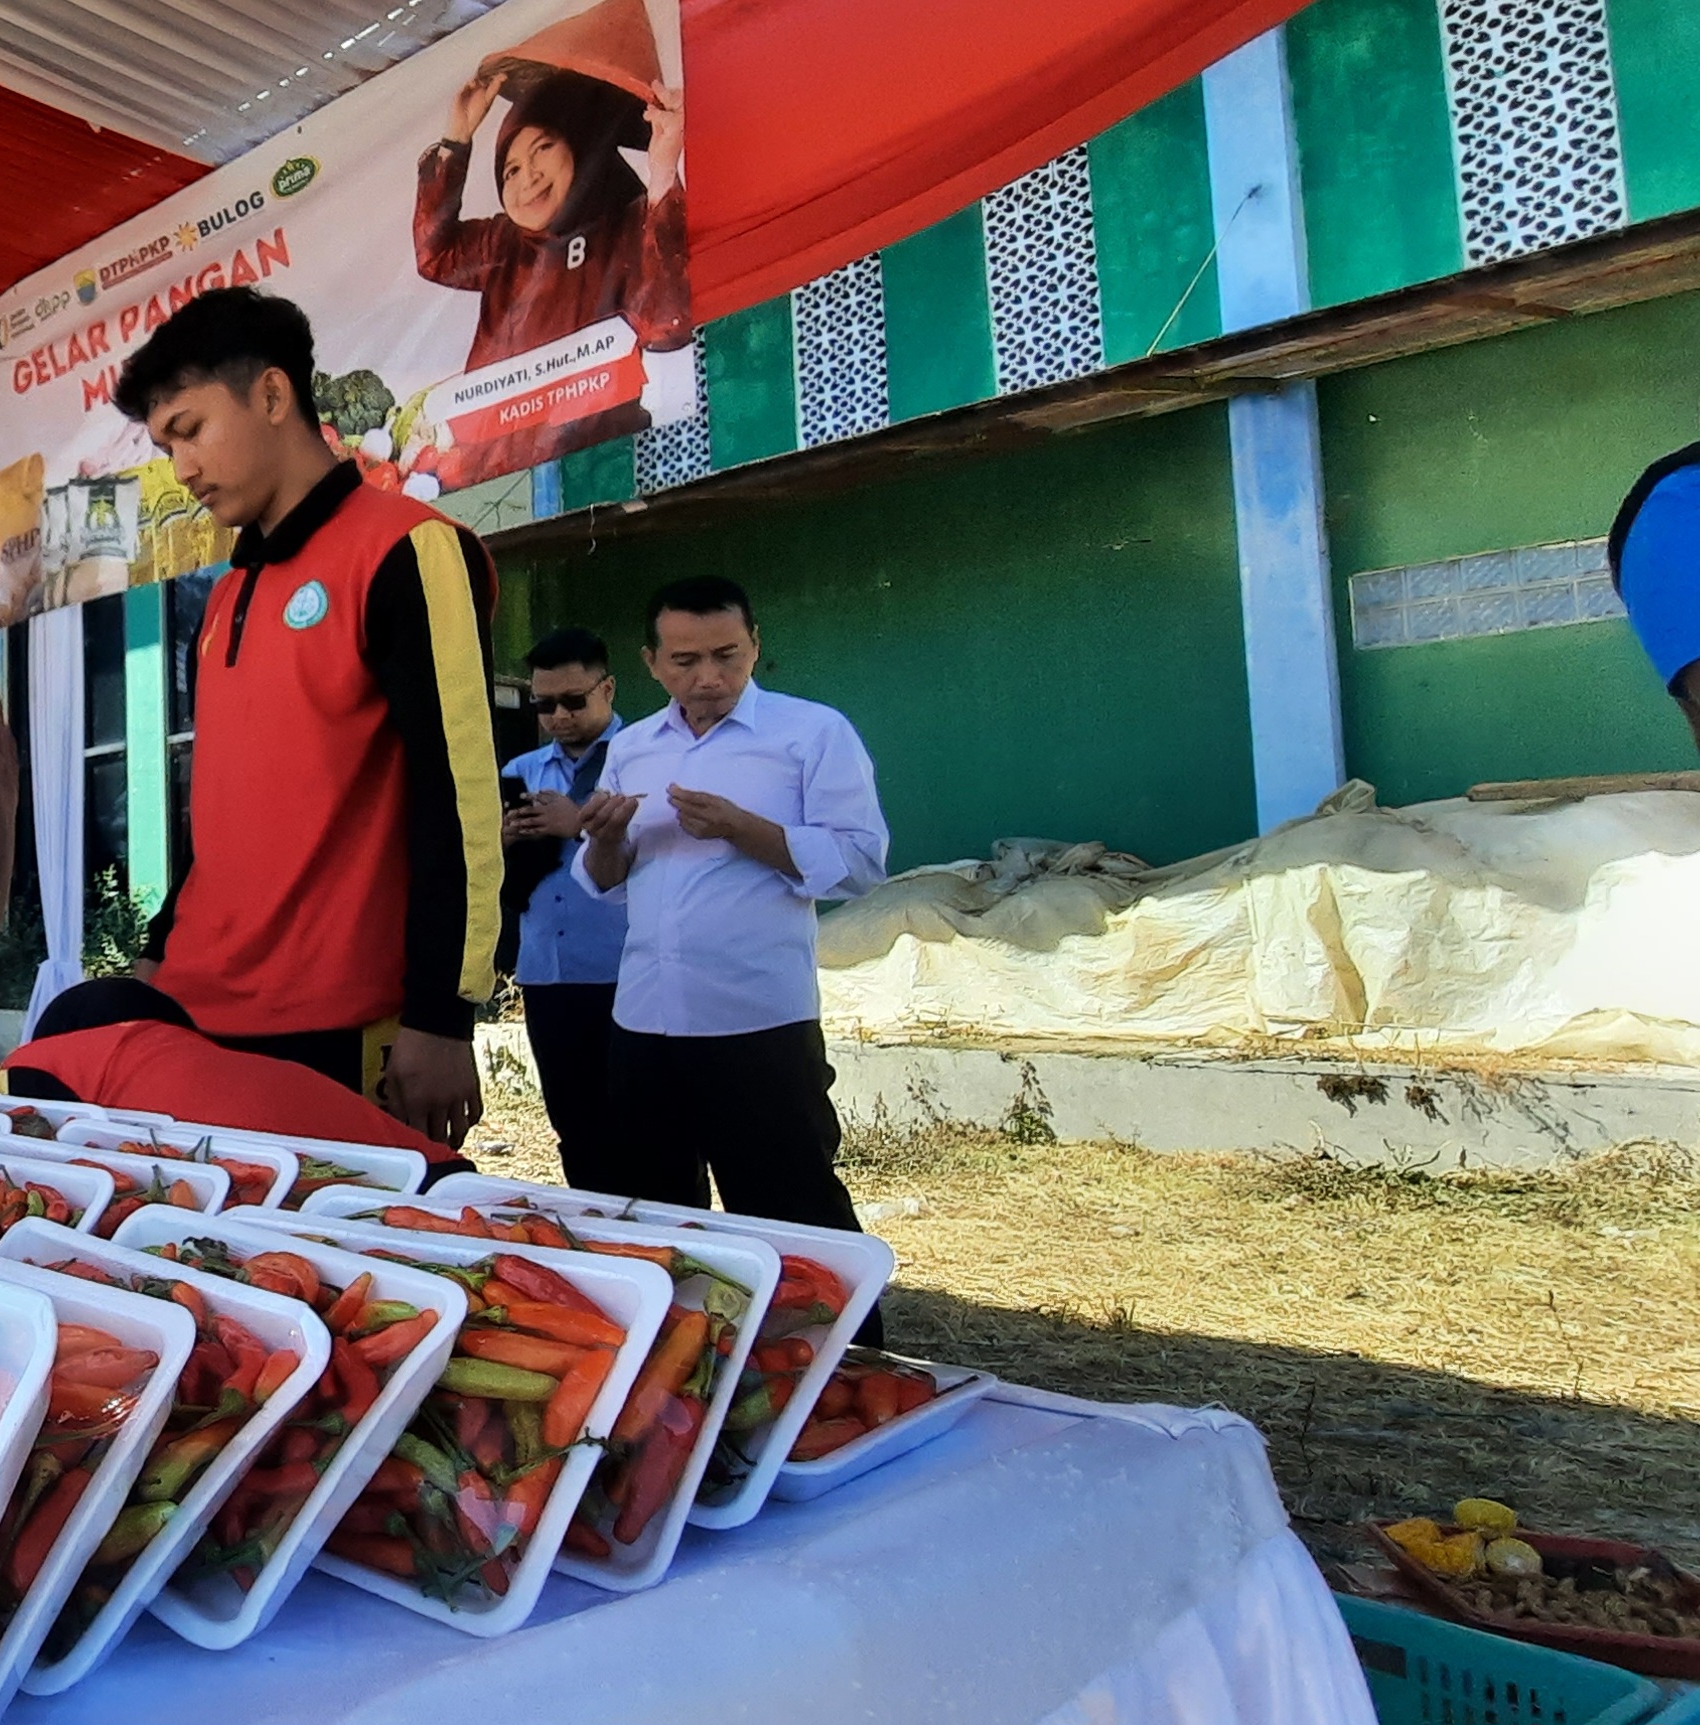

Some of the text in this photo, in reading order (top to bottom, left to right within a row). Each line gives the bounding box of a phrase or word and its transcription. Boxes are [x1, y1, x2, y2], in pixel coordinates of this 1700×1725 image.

[278, 165, 311, 192] prima
[196, 190, 266, 238] BULOG
[566, 236, 587, 271] B
[13, 320, 111, 394] GELAR
[119, 228, 290, 342] PANGAN
[454, 368, 531, 404] NURDIYATI,
[499, 371, 610, 425] KADIS TPHPKP
